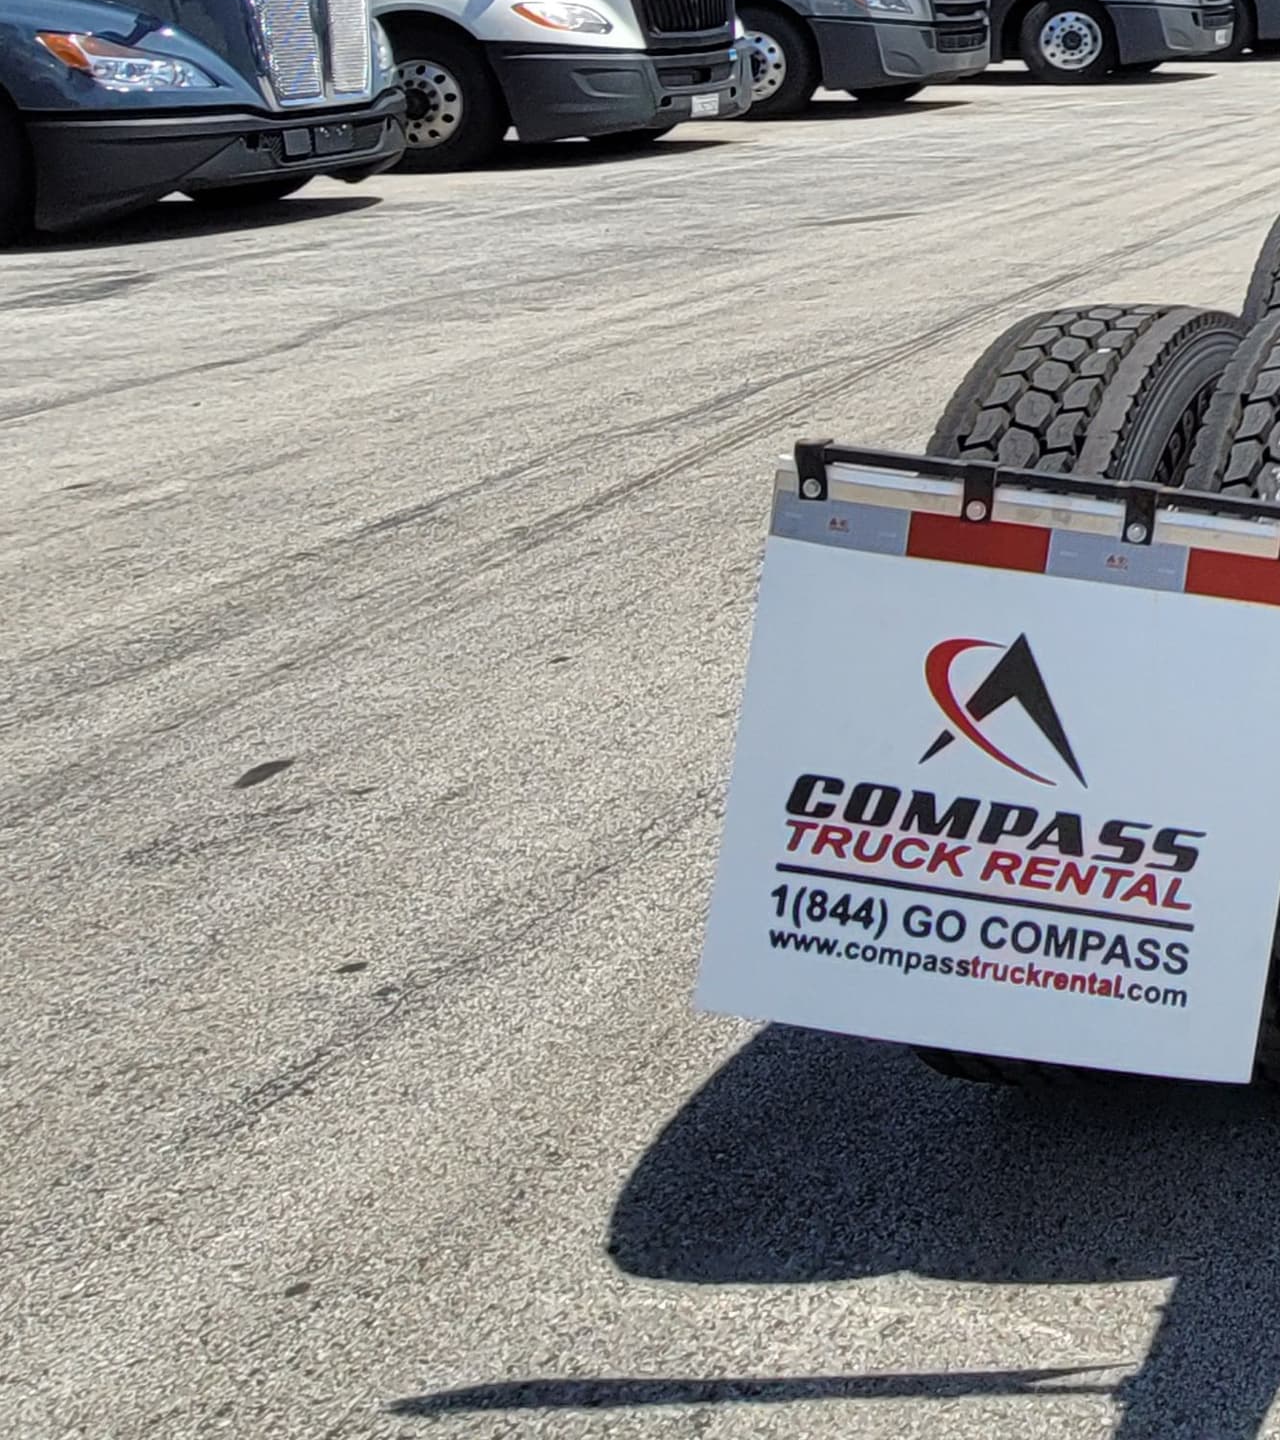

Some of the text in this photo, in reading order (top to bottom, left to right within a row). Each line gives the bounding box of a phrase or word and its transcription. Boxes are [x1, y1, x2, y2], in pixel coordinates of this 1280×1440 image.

[785, 774, 1206, 873] COMPASS
[786, 819, 1193, 910] TRUCK RENTAL
[769, 929, 1188, 1008] www.compasstruckrental.com
[771, 884, 1190, 976] 1(844) GO COMPASS
